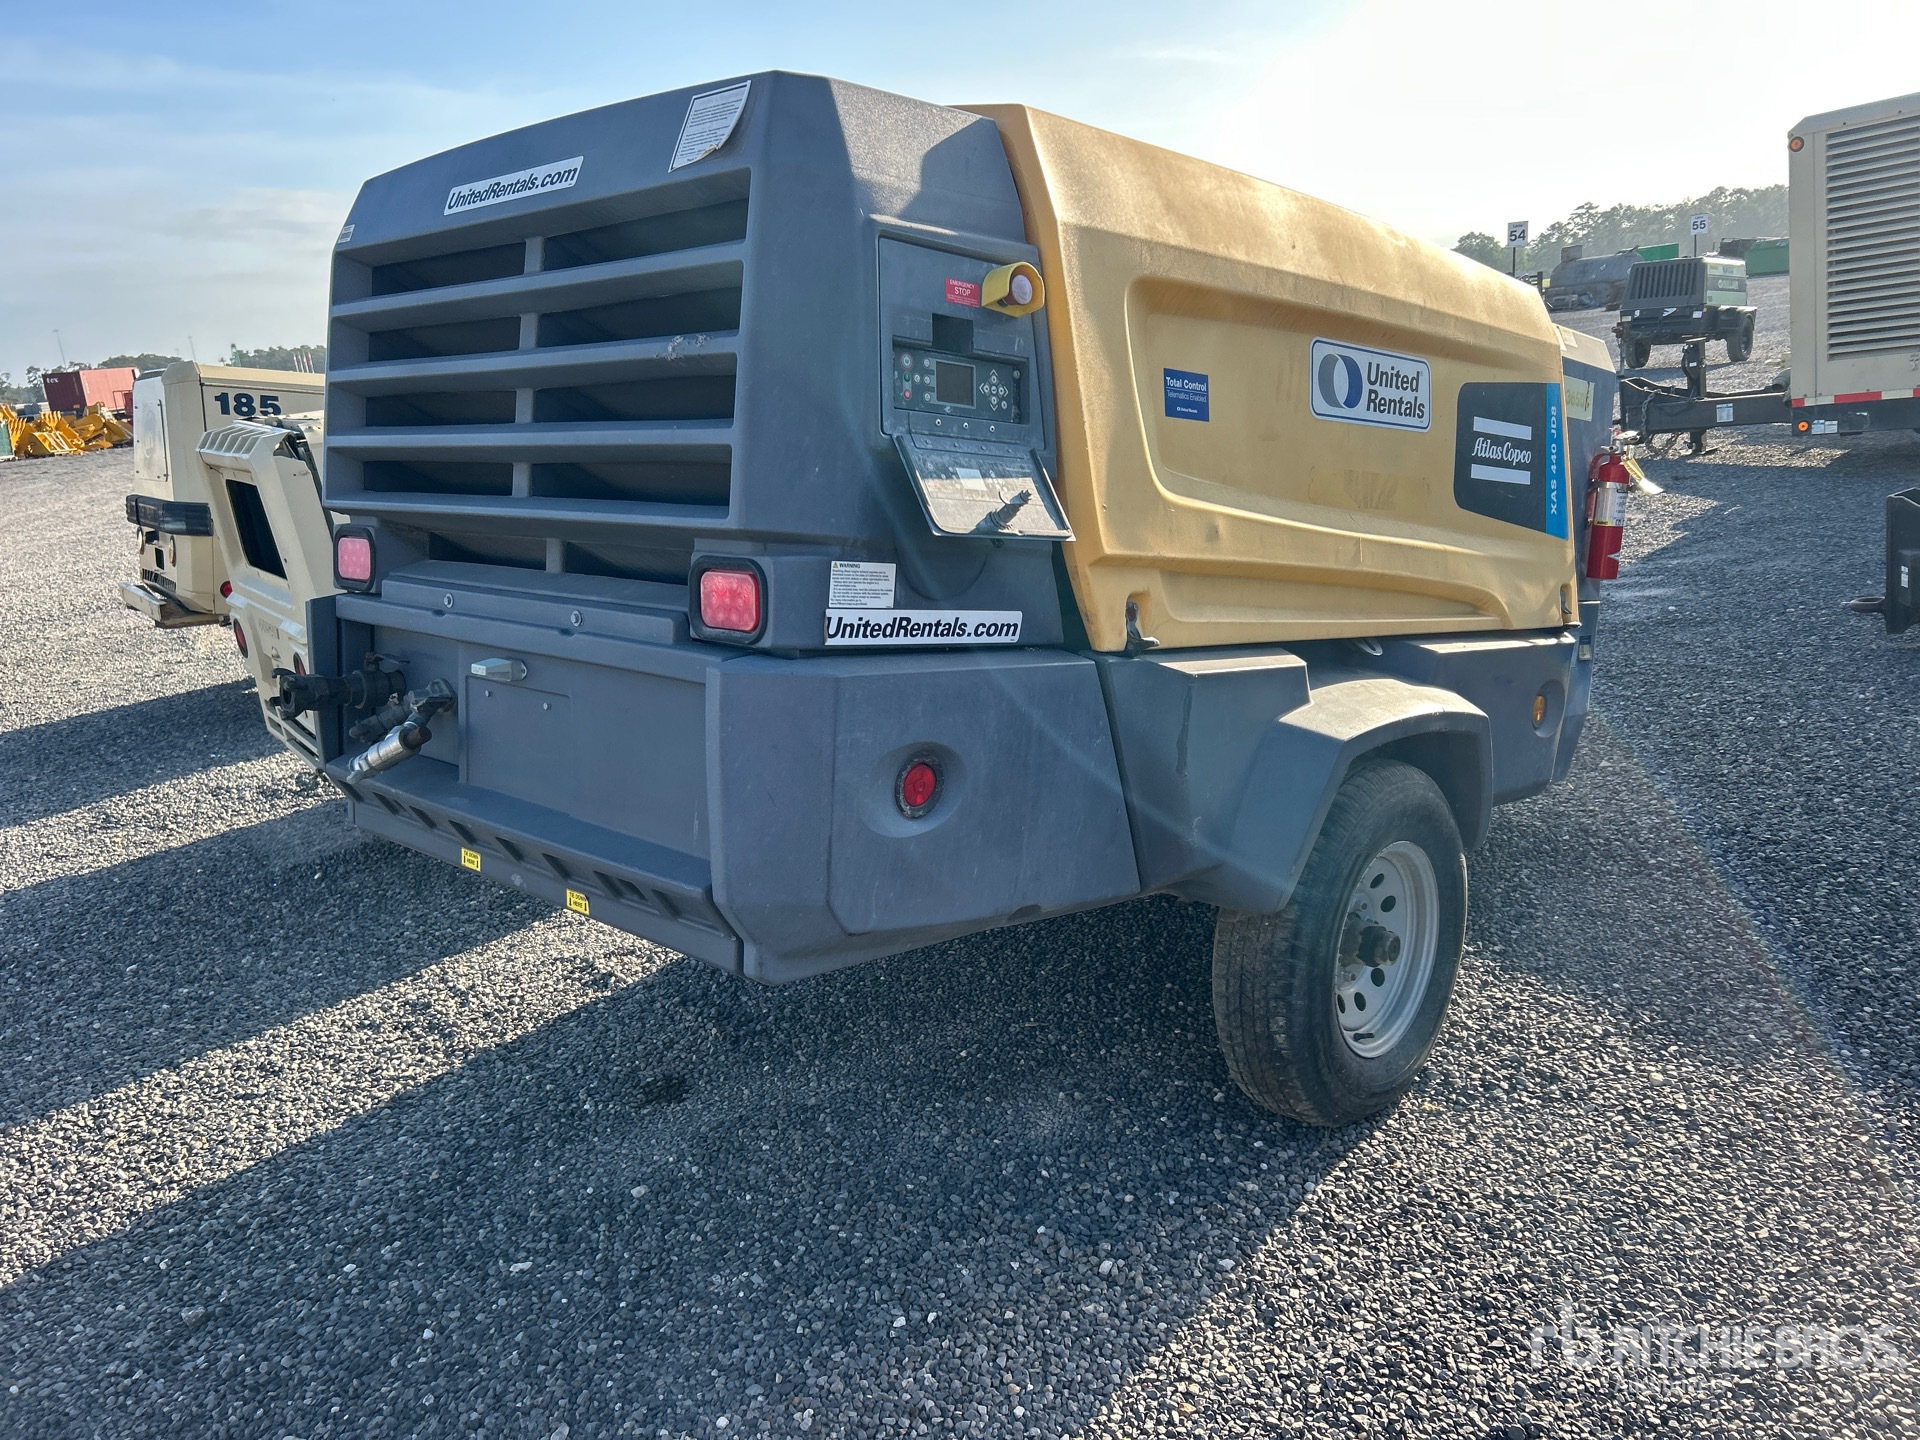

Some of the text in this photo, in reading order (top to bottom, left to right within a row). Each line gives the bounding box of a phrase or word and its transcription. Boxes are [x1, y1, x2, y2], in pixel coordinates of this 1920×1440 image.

[447, 167, 579, 210] UnitedRentals.com
[1509, 229, 1526, 242] 54
[1692, 219, 1706, 230] 55
[949, 278, 975, 290] EMERGENCY
[954, 286, 971, 297] STOP
[1165, 376, 1207, 392] Total Control
[1366, 361, 1420, 393] United
[214, 392, 282, 417] 185
[1366, 388, 1425, 419] Rentals
[1550, 405, 1558, 439] JD8
[1472, 437, 1532, 466] Atlas Copco
[1550, 479, 1558, 515] XAS
[826, 616, 1019, 639] UnitedRentals.com
